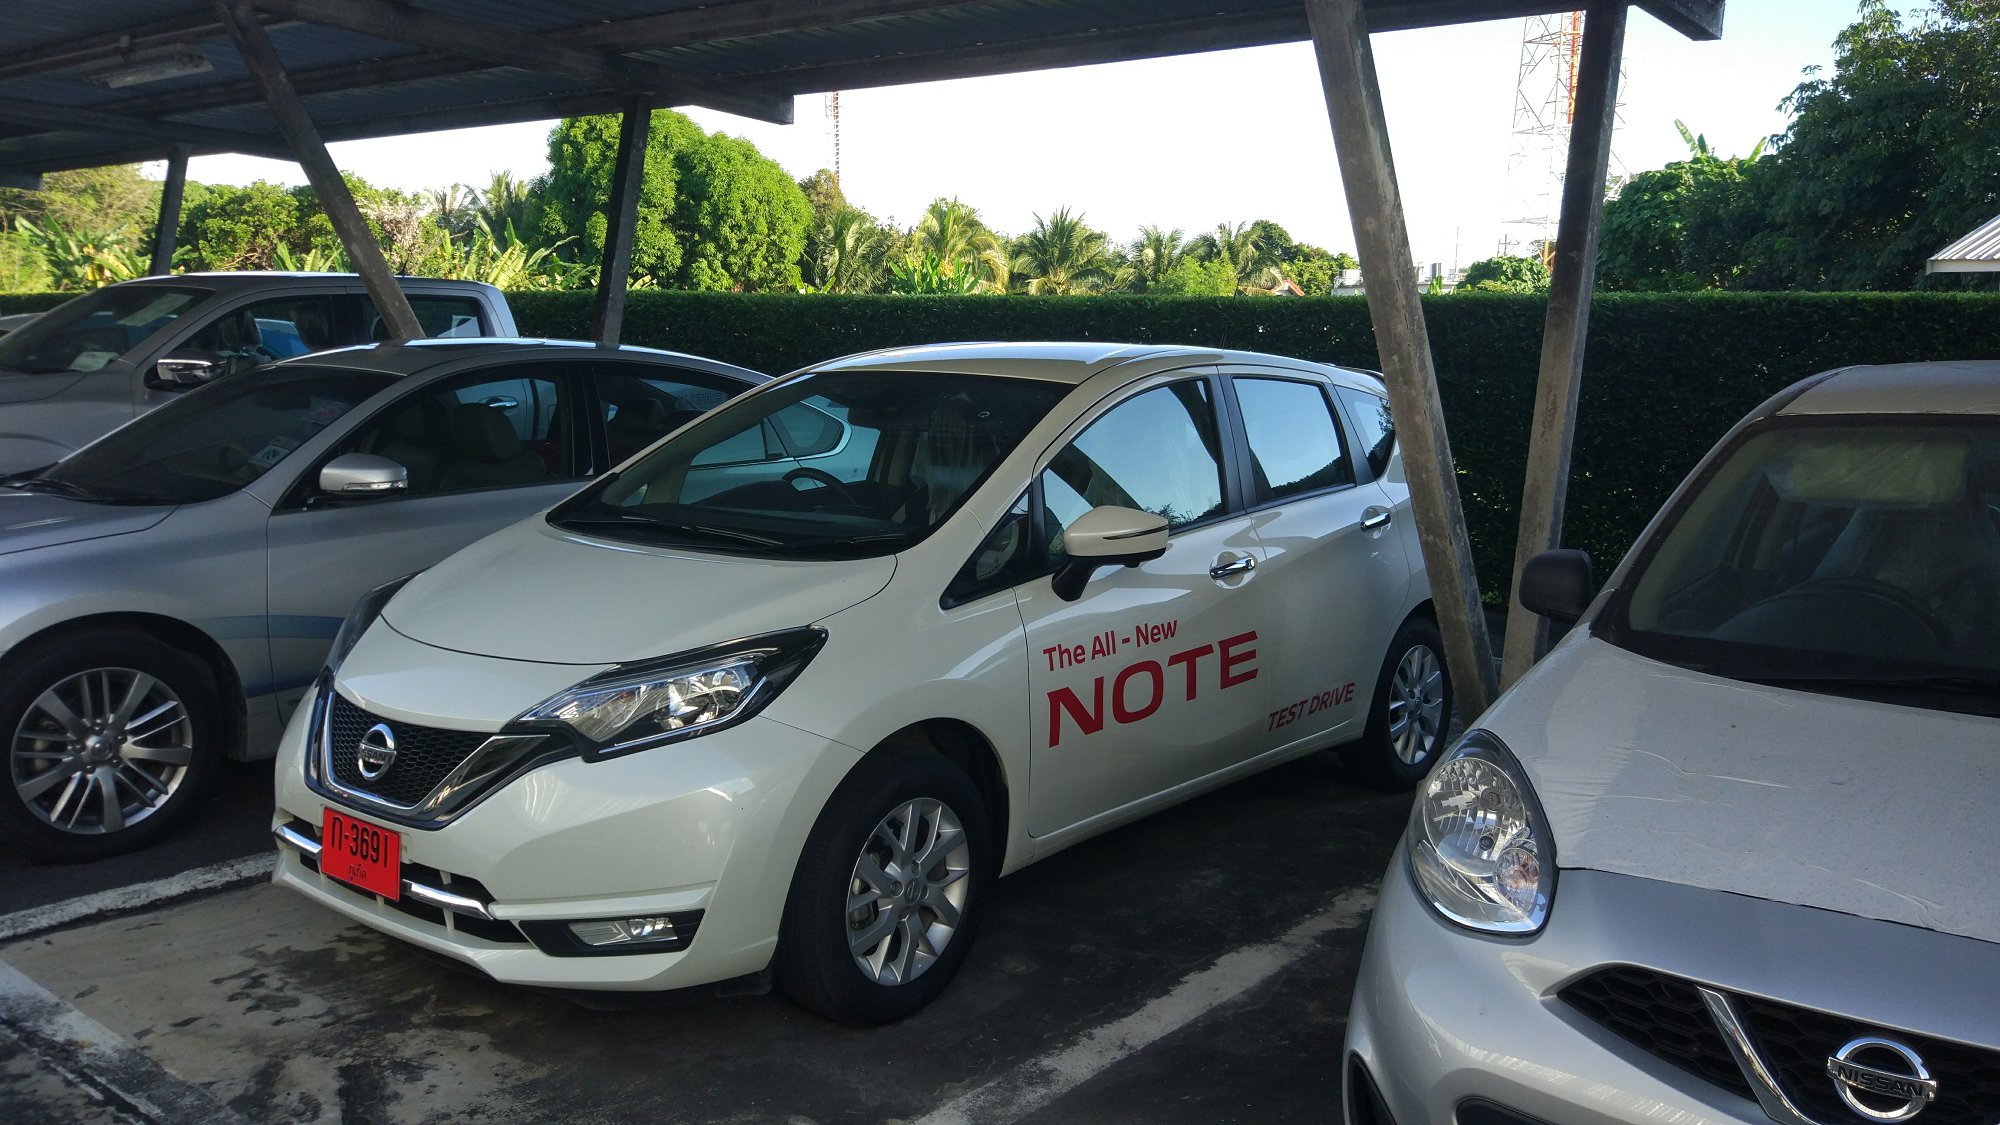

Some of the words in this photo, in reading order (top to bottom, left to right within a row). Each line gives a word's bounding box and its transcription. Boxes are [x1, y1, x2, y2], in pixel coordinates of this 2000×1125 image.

[1043, 643, 1086, 672] The
[1091, 630, 1117, 660] All
[1135, 620, 1178, 648] New
[1047, 630, 1259, 748] NOTE
[1268, 699, 1308, 732] TEST
[1308, 682, 1355, 716] DRIVE
[331, 815, 389, 868] ก-3691
[1836, 1063, 1925, 1099] NISSAN
